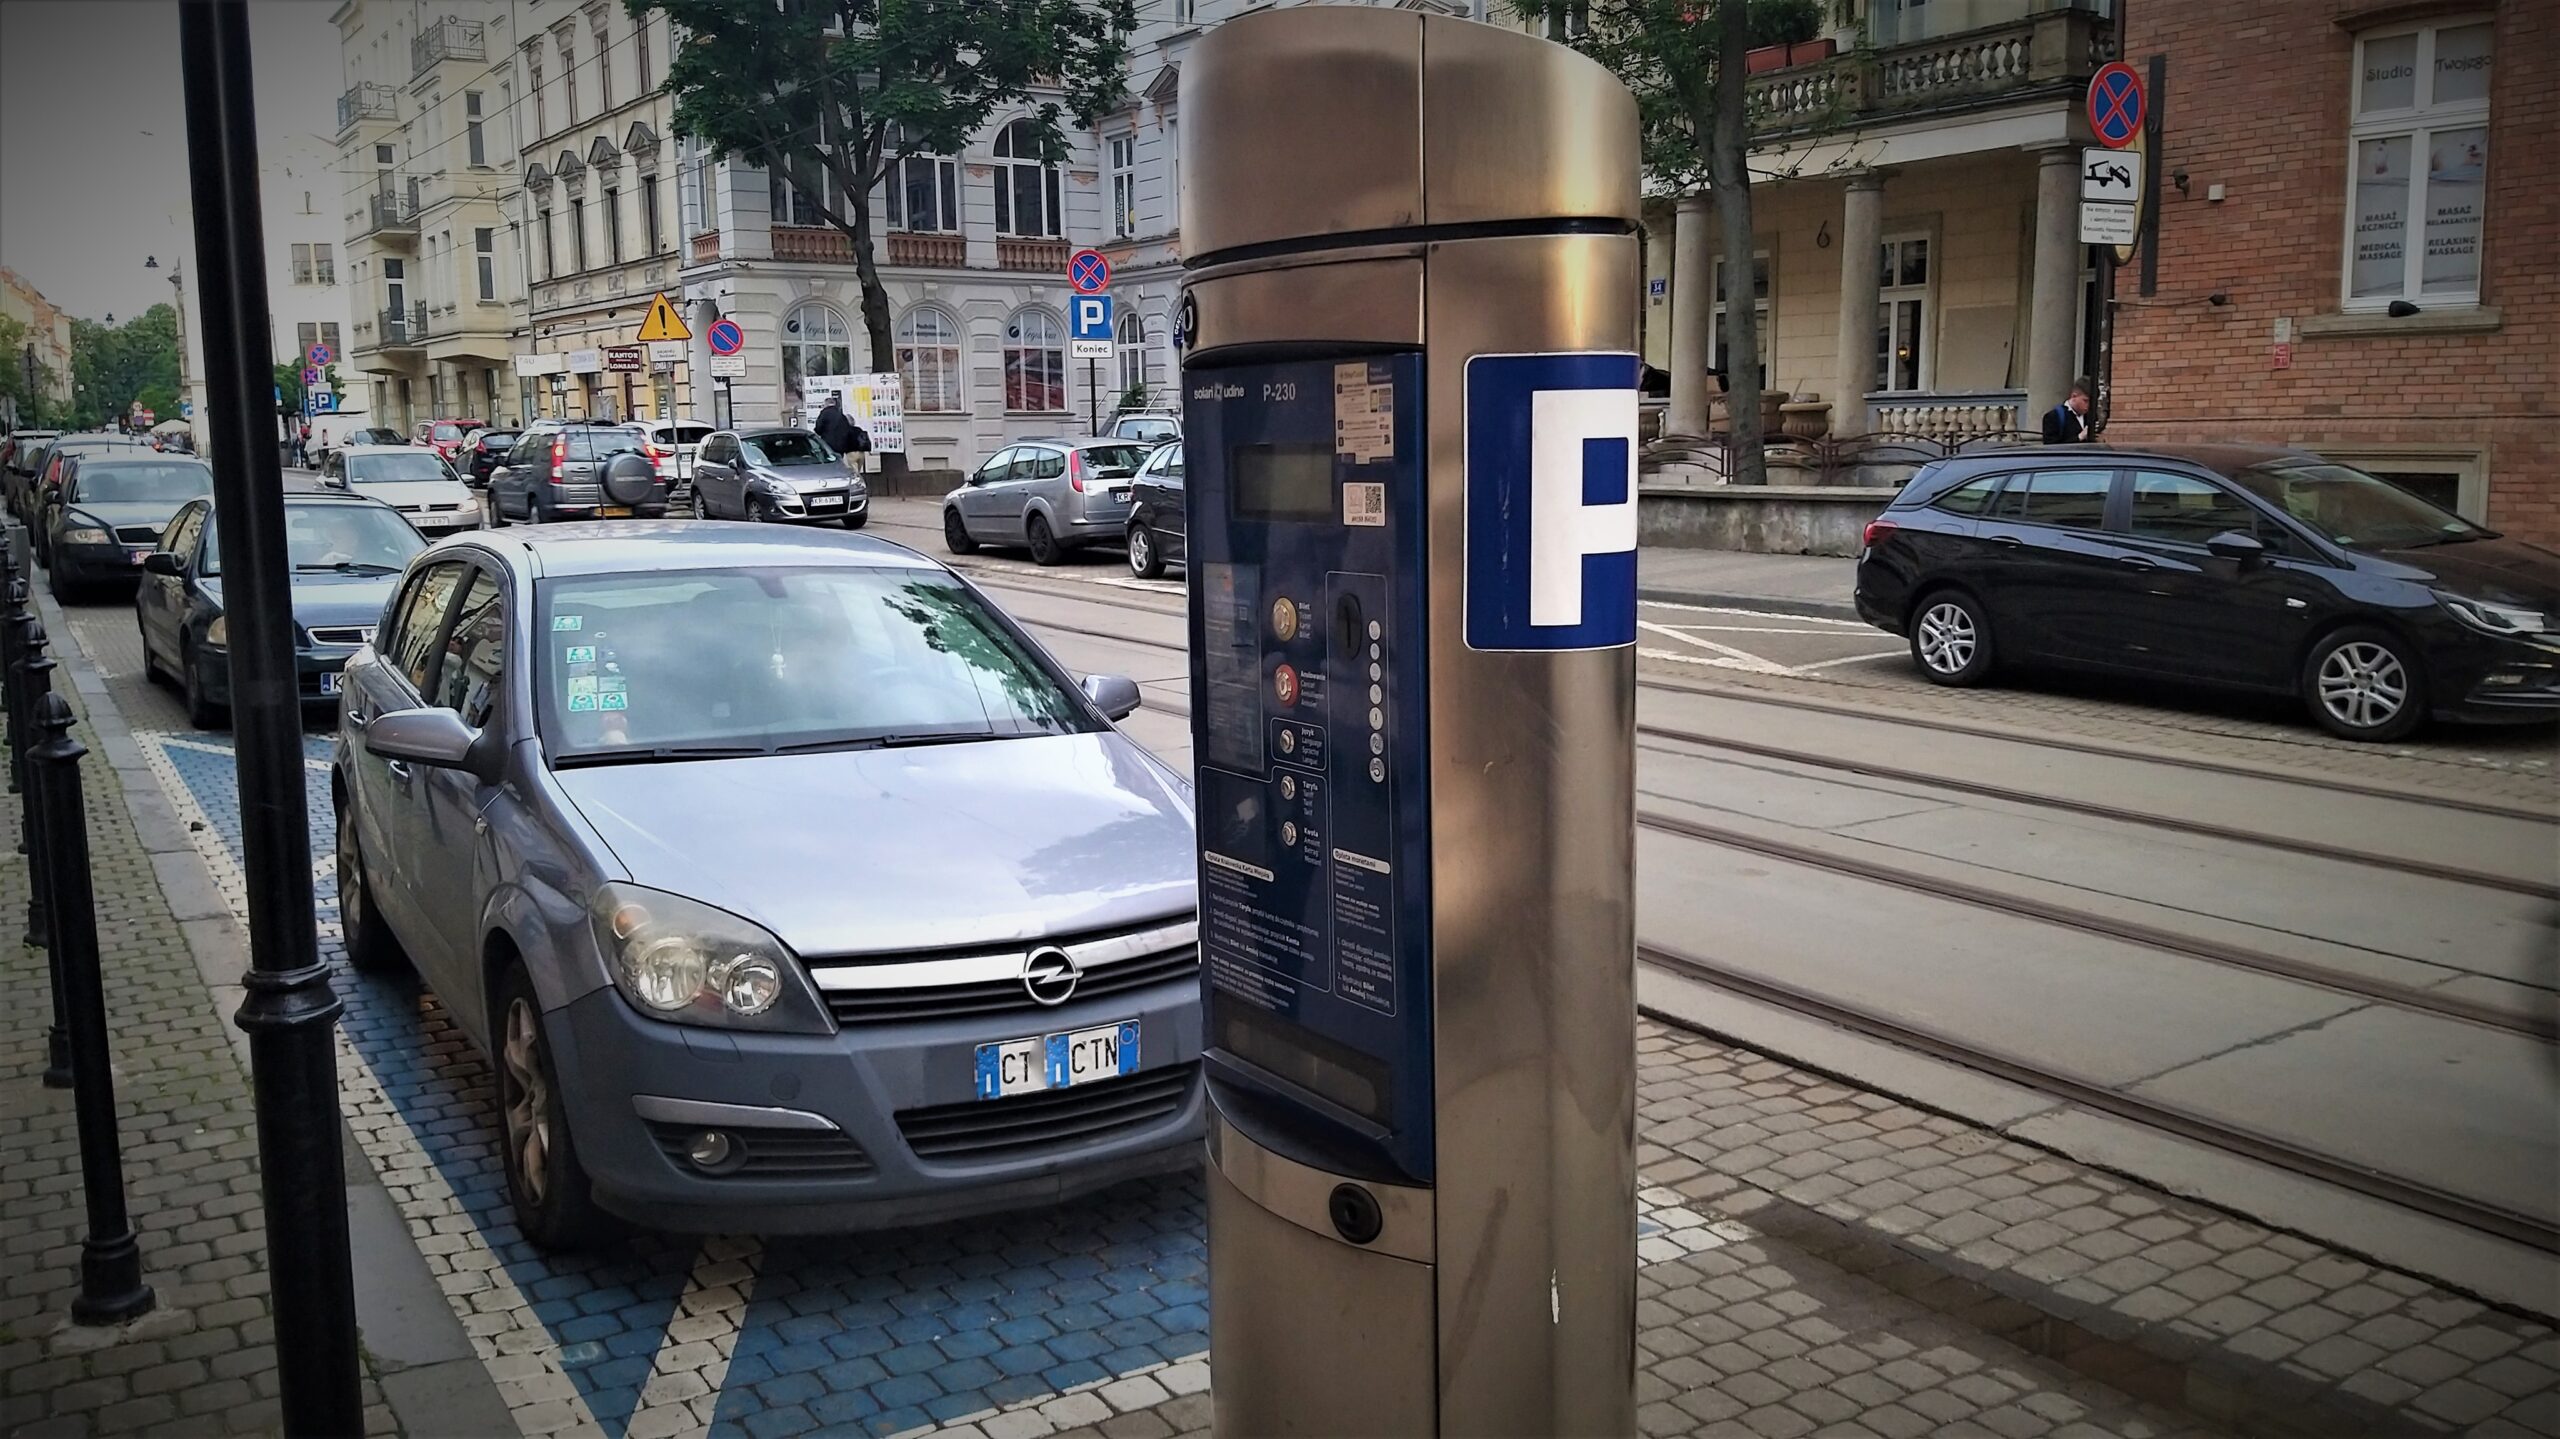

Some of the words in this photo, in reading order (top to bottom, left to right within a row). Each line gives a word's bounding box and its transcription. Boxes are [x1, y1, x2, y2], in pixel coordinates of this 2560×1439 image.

[2366, 65, 2414, 81] Studio
[2438, 205, 2472, 216] MASAŻ
[2361, 242, 2402, 252] MEDICAL
[2428, 236, 2476, 247] RELAXING
[2359, 251, 2402, 261] MASSAGE
[2429, 246, 2475, 256] MASSAGE
[1080, 300, 1104, 334] P
[1076, 344, 1108, 353] Koniec
[1193, 386, 1214, 400] solari
[1223, 384, 1245, 398] udine
[1263, 383, 1296, 402] P-230
[1530, 389, 1639, 626] P
[1002, 1051, 1030, 1084] CT
[1071, 1035, 1117, 1074] CTN
